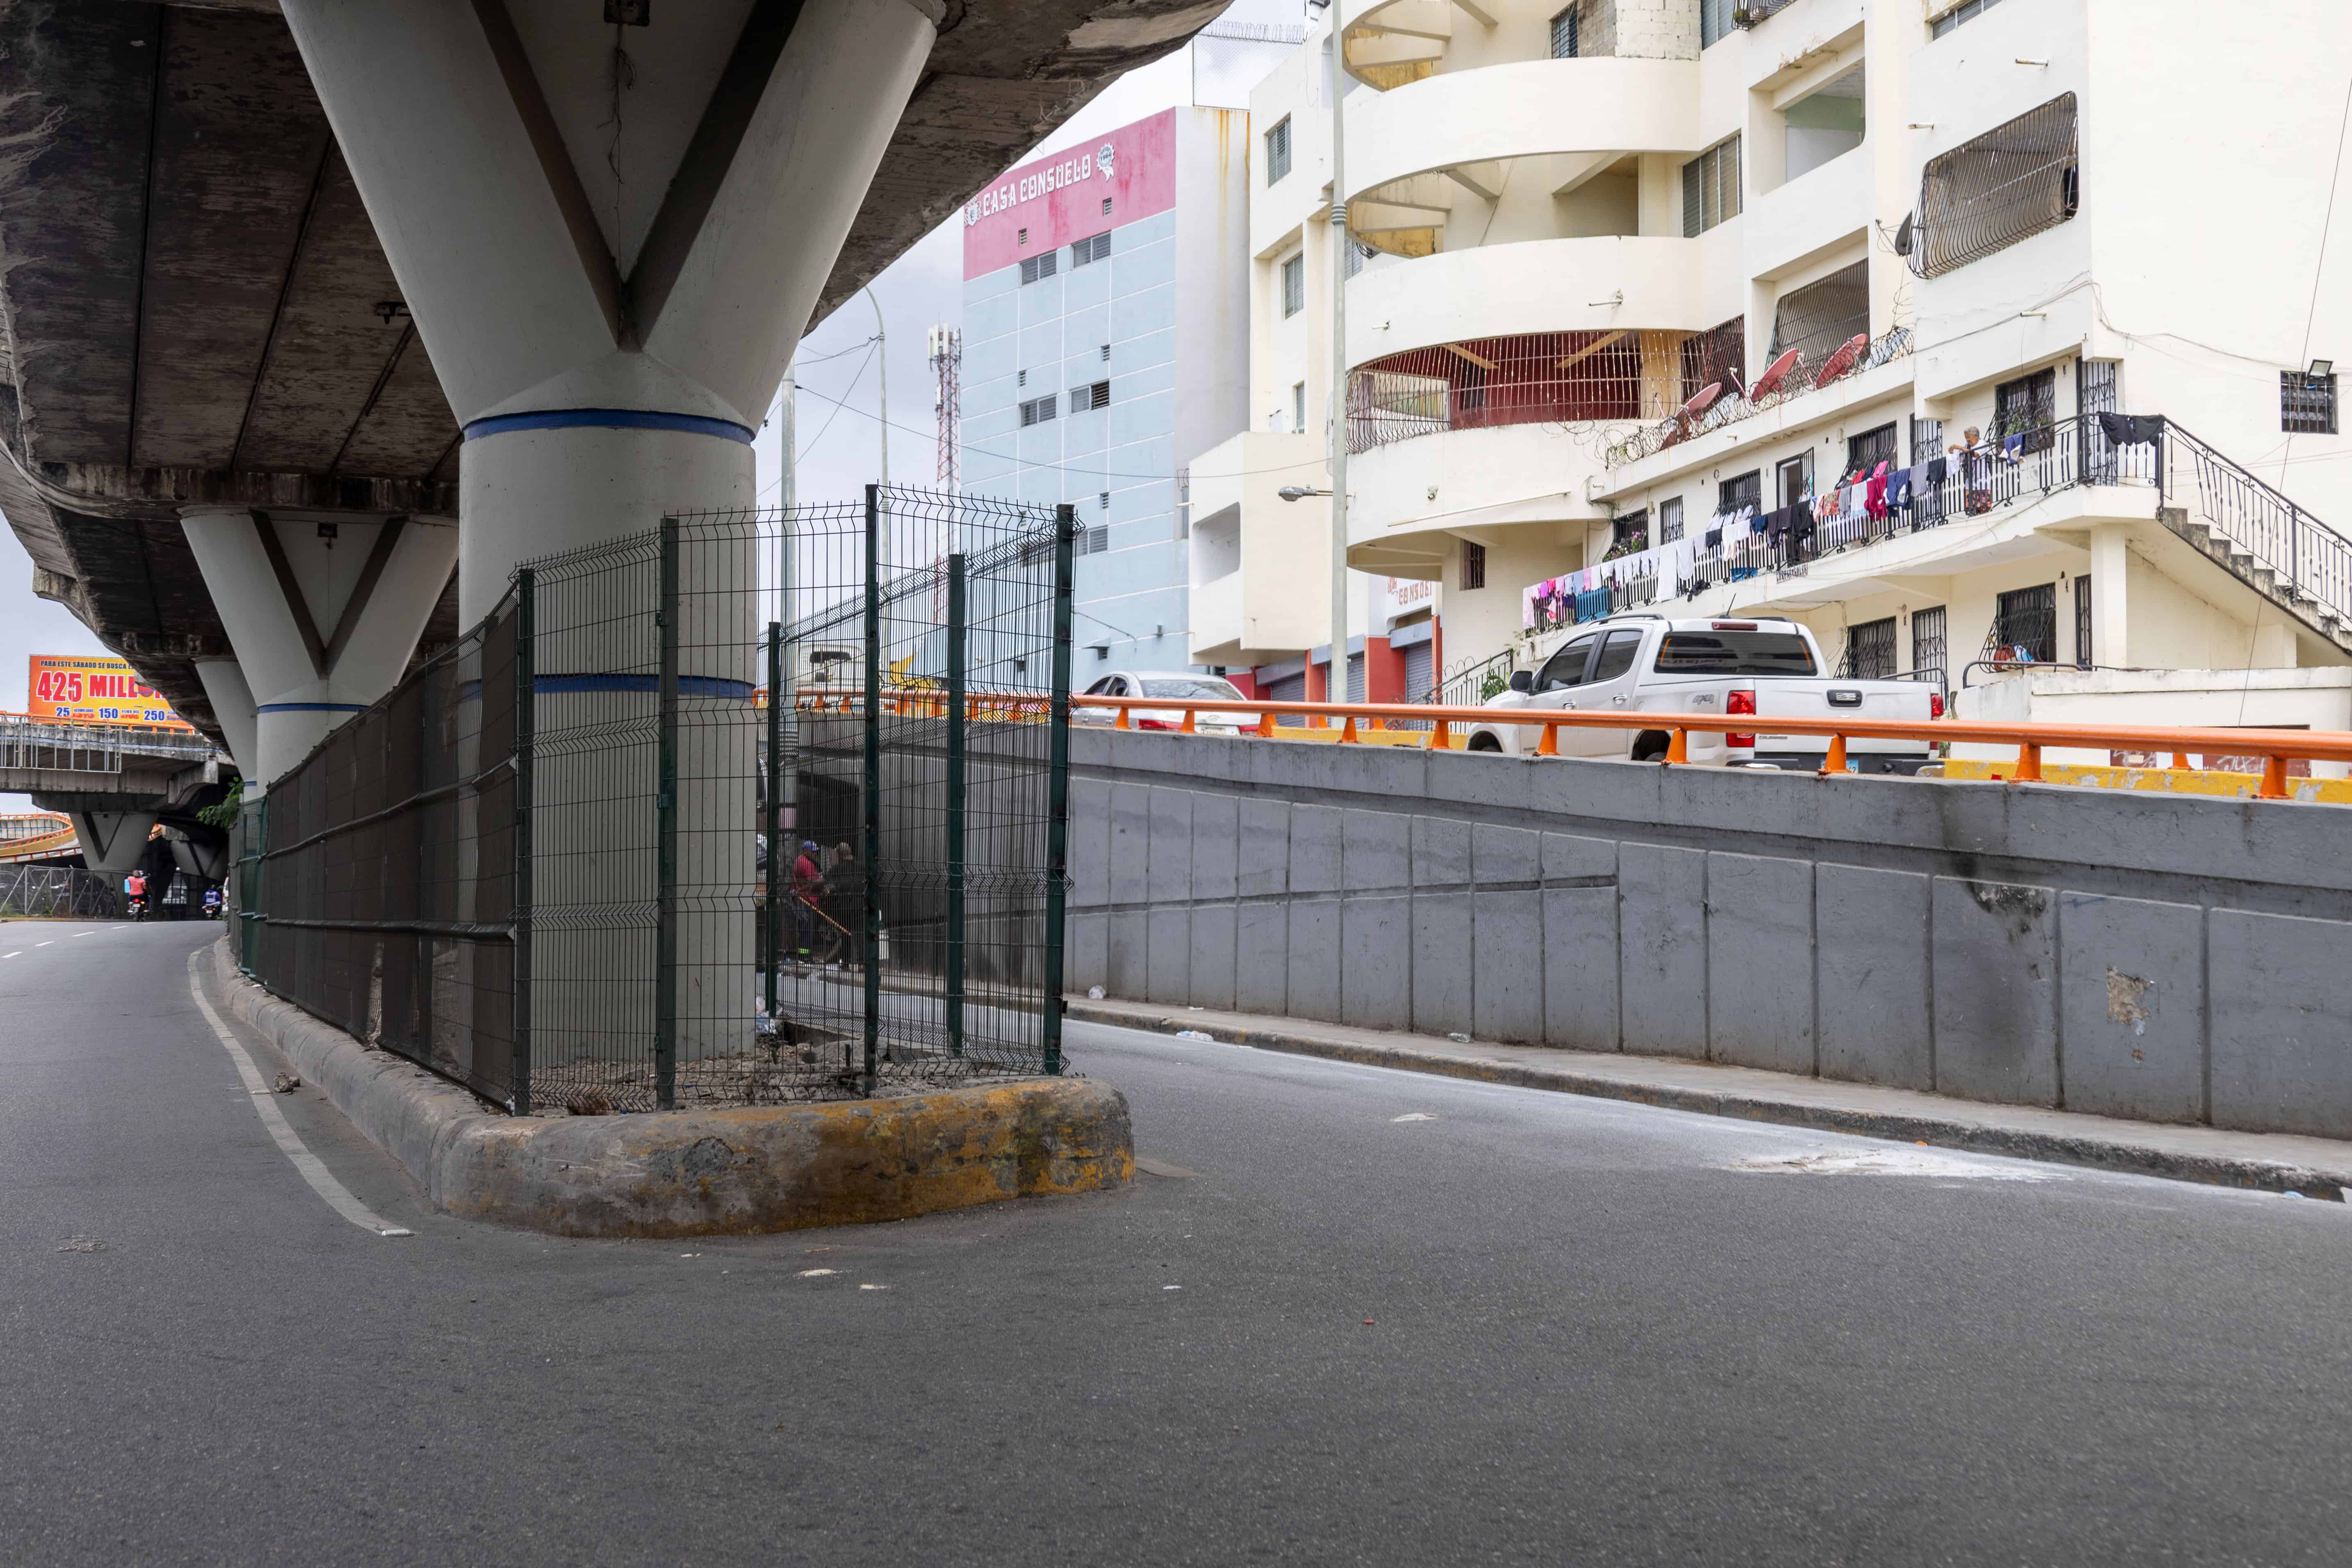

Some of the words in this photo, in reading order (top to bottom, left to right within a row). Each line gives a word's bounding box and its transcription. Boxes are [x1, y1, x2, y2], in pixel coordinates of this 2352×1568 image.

[983, 184, 1017, 217] CASA
[1020, 154, 1091, 203] CONSUELO
[36, 671, 82, 702] 425
[56, 707, 70, 716] 25
[99, 708, 118, 719] 150
[144, 710, 164, 721] 250
